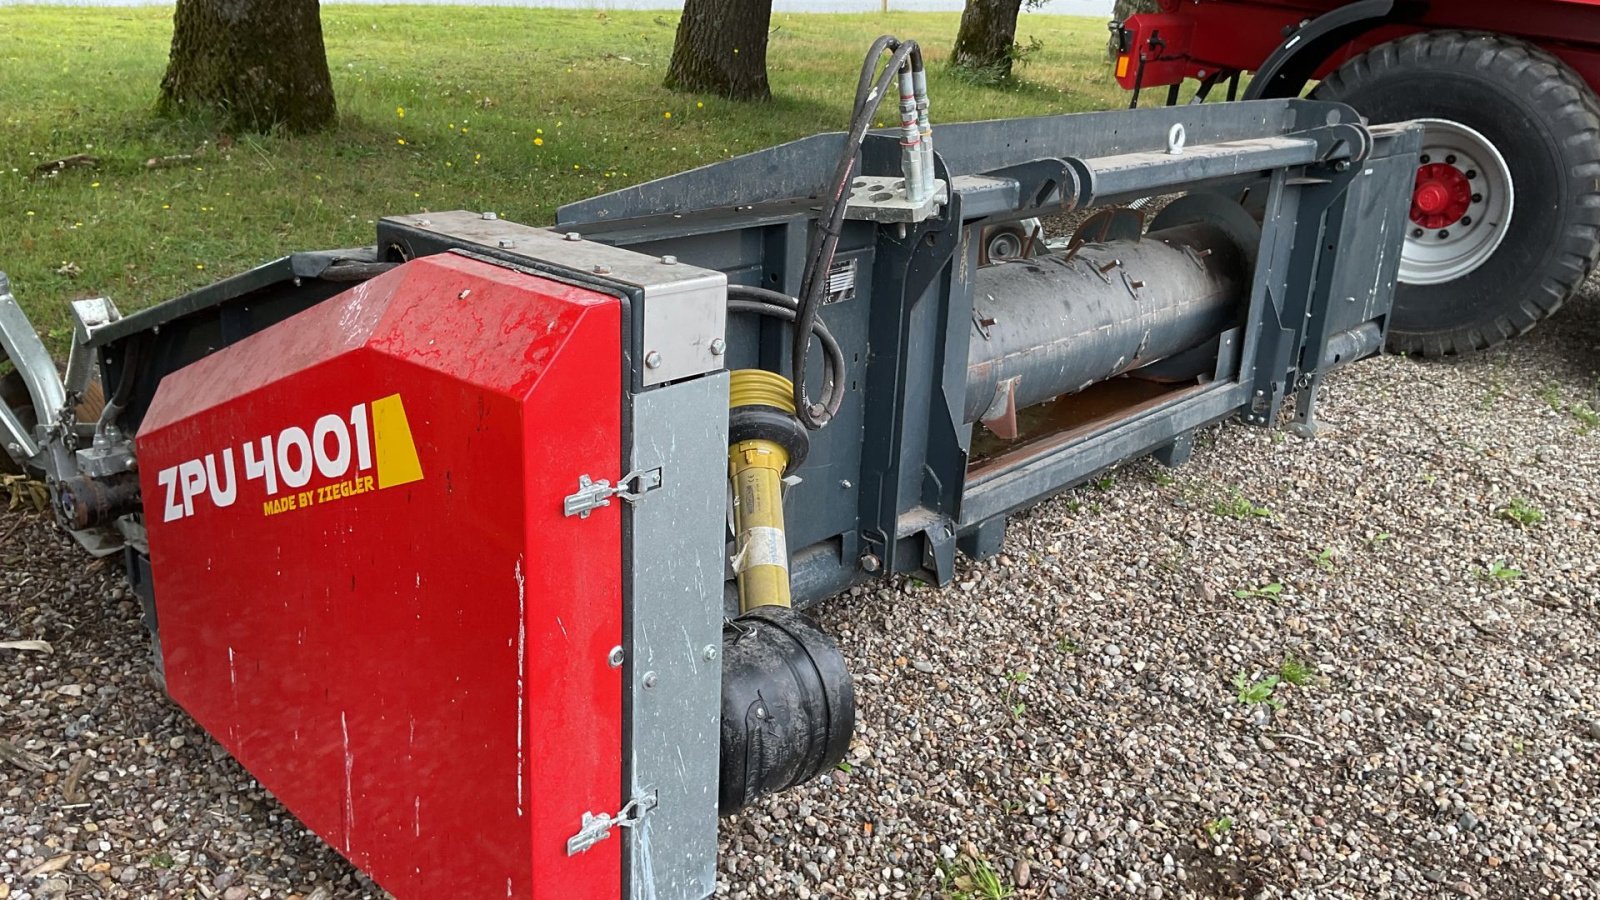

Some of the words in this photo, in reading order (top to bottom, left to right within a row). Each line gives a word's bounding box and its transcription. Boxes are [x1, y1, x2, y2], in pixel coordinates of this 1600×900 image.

[158, 447, 237, 522] ZPU
[243, 403, 372, 495] 4001
[264, 496, 296, 516] MADE
[299, 490, 315, 507] BY
[317, 475, 375, 503] ZIEGLER
